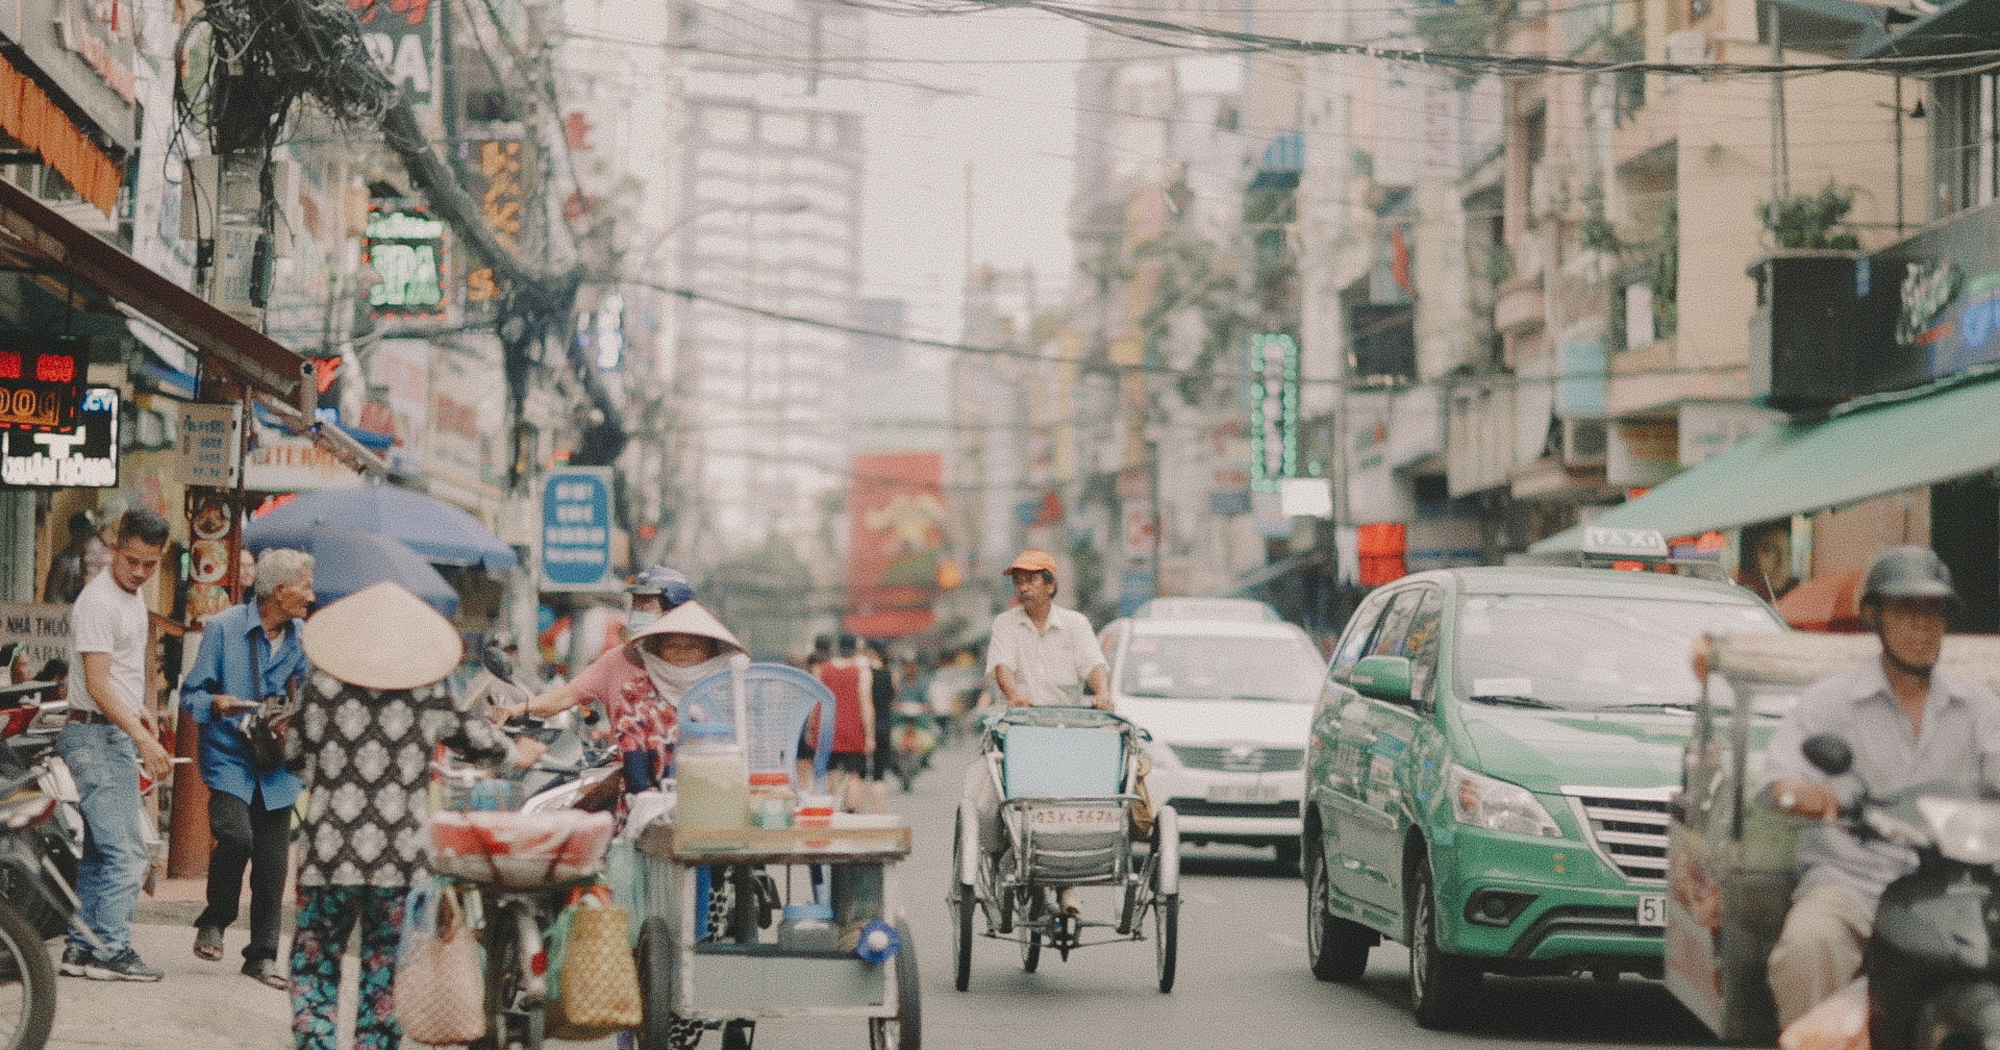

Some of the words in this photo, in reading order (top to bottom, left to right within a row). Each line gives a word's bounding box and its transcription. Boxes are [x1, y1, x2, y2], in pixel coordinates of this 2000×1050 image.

[362, 32, 431, 93] PA
[1592, 528, 1662, 550] TAXI
[1643, 898, 1666, 922] 51
